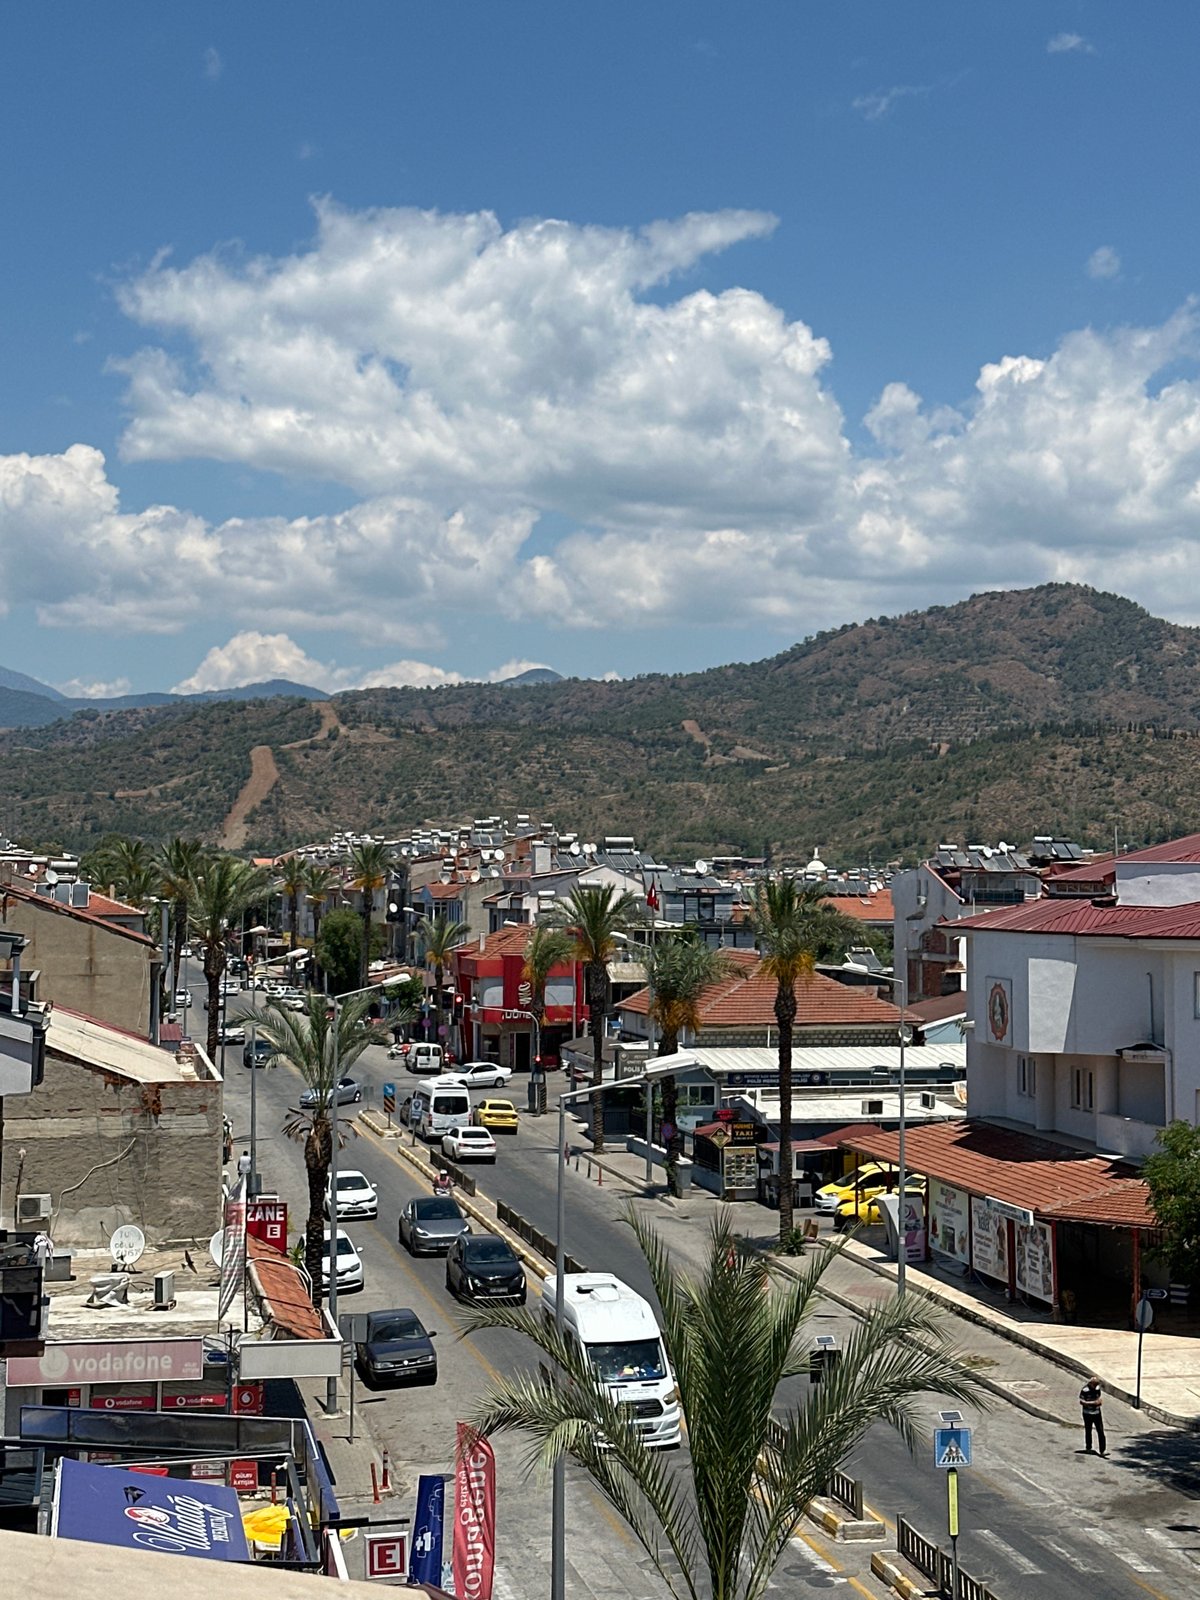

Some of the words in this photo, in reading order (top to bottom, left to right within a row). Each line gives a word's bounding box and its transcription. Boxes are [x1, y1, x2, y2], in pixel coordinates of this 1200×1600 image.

[246, 1205, 285, 1222] ZANE
[72, 1352, 173, 1373] vodafone
[186, 1396, 214, 1405] vodafone
[209, 1514, 230, 1542] PREMIUM
[377, 1544, 397, 1569] E
